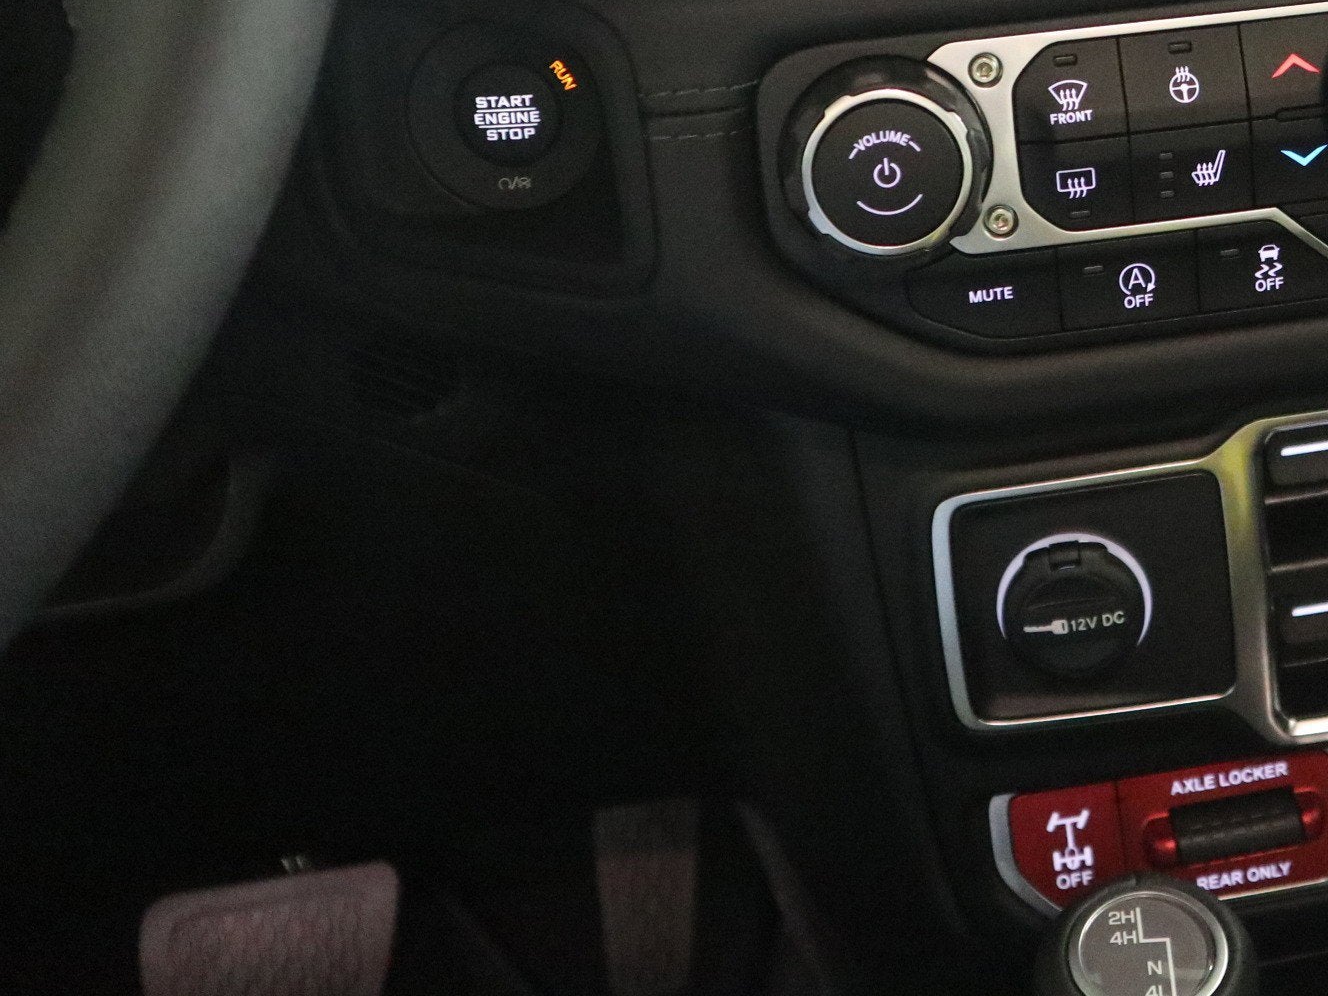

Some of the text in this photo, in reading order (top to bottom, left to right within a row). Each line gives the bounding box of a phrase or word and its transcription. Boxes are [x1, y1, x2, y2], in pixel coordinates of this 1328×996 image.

[549, 59, 578, 91] RUN
[475, 94, 533, 109] START
[474, 110, 541, 126] ENGINE
[1049, 109, 1093, 125] FRONT
[486, 128, 536, 141] STOP
[853, 130, 911, 152] VOLUME
[1255, 277, 1284, 293] OFF
[969, 286, 1013, 304] MUTE
[1124, 293, 1154, 309] OFF
[1070, 611, 1125, 632] 12V DC
[1170, 762, 1289, 796] AXLE LOCKER
[1055, 870, 1093, 890] OFF
[1196, 861, 1293, 891] REAR ONLY
[1108, 910, 1135, 925] 2H
[1110, 930, 1136, 946] 4H
[1147, 960, 1162, 975] N
